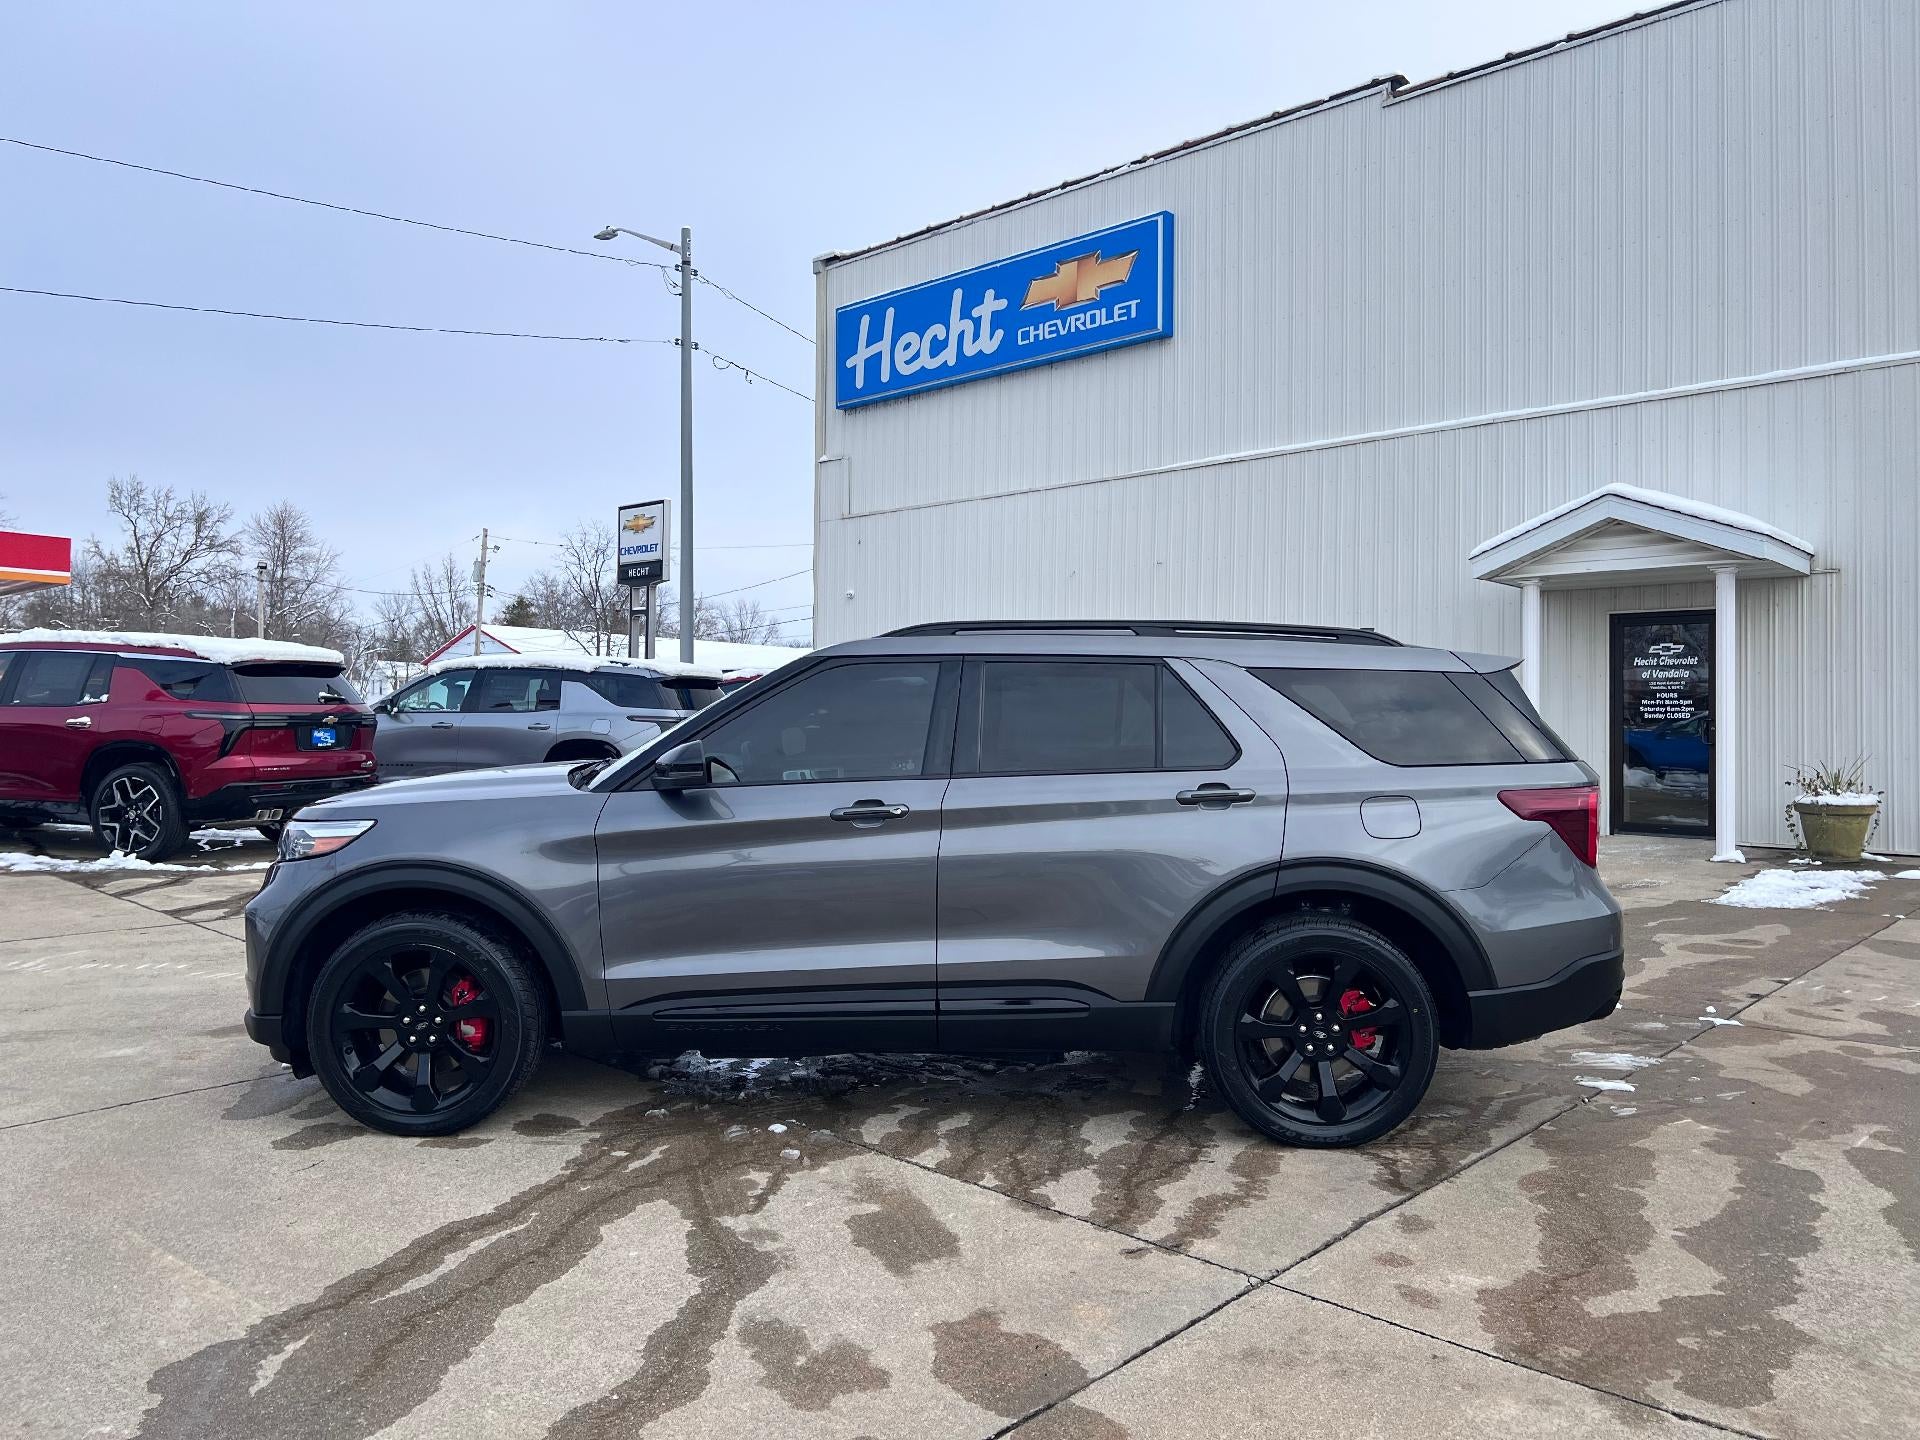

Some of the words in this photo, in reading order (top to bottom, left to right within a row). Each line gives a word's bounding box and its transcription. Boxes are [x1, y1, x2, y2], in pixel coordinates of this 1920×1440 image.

[846, 287, 1008, 390] Hecht
[1017, 299, 1141, 346] CHEVROLET
[620, 543, 659, 556] CHEVROLET
[628, 567, 649, 577] HECHT
[1633, 657, 1657, 666] Hecht
[1659, 656, 1698, 665] Chevrolet
[1641, 669, 1651, 678] of
[1652, 668, 1690, 678] Vandalia
